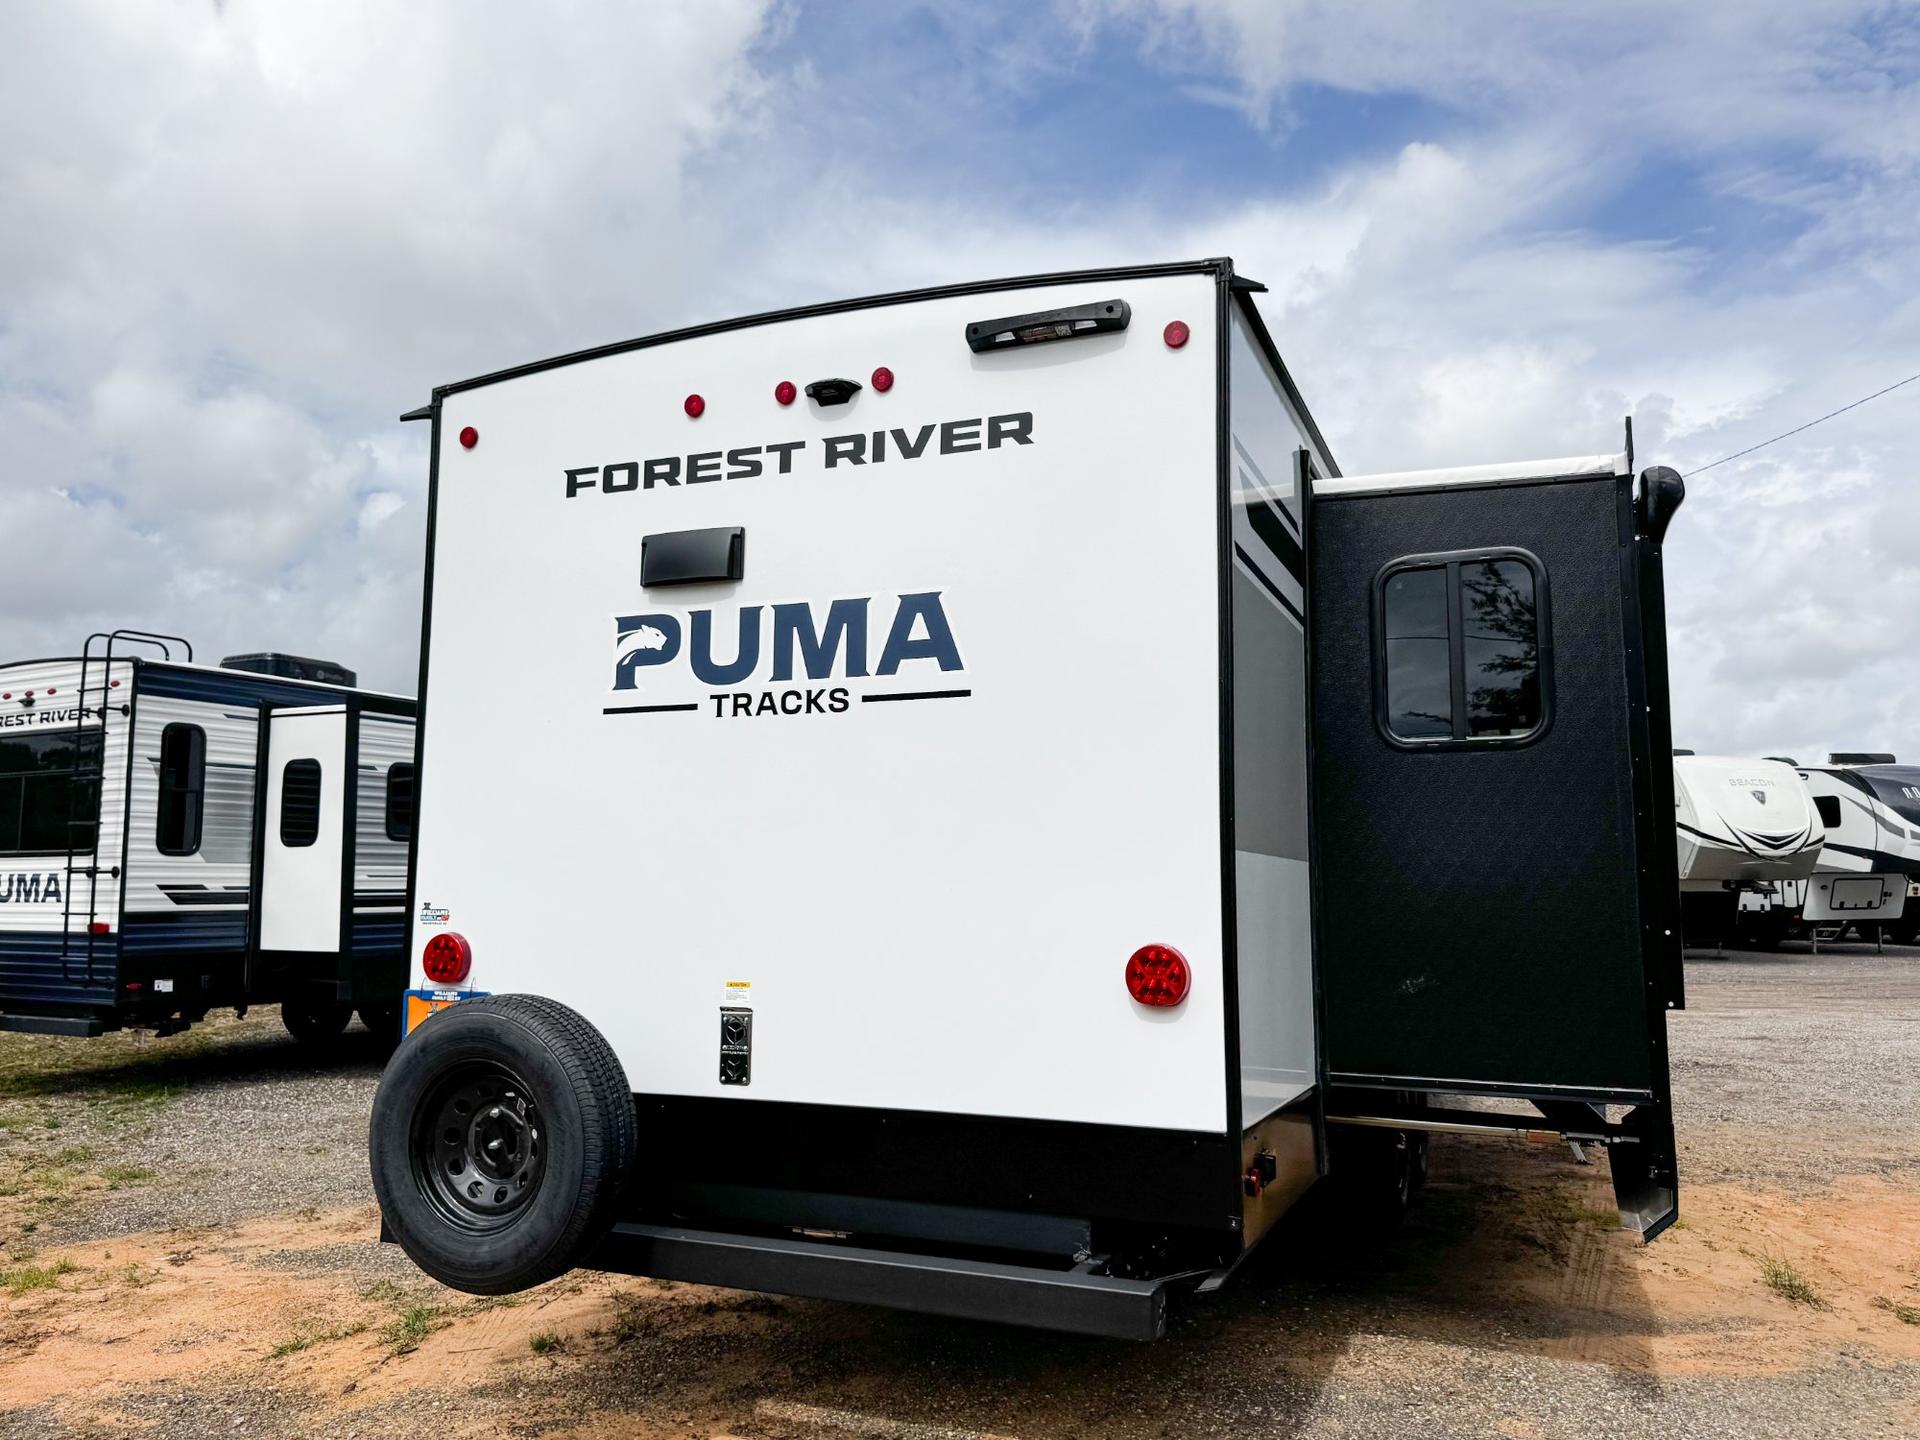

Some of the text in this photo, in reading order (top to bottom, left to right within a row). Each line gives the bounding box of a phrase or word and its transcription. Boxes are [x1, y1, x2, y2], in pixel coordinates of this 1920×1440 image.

[564, 411, 1035, 499] FOREST RIVER
[612, 591, 965, 691] PUMA
[39, 708, 90, 723] RIVER
[709, 688, 850, 718] TRACKS
[1728, 778, 1776, 786] BEACON
